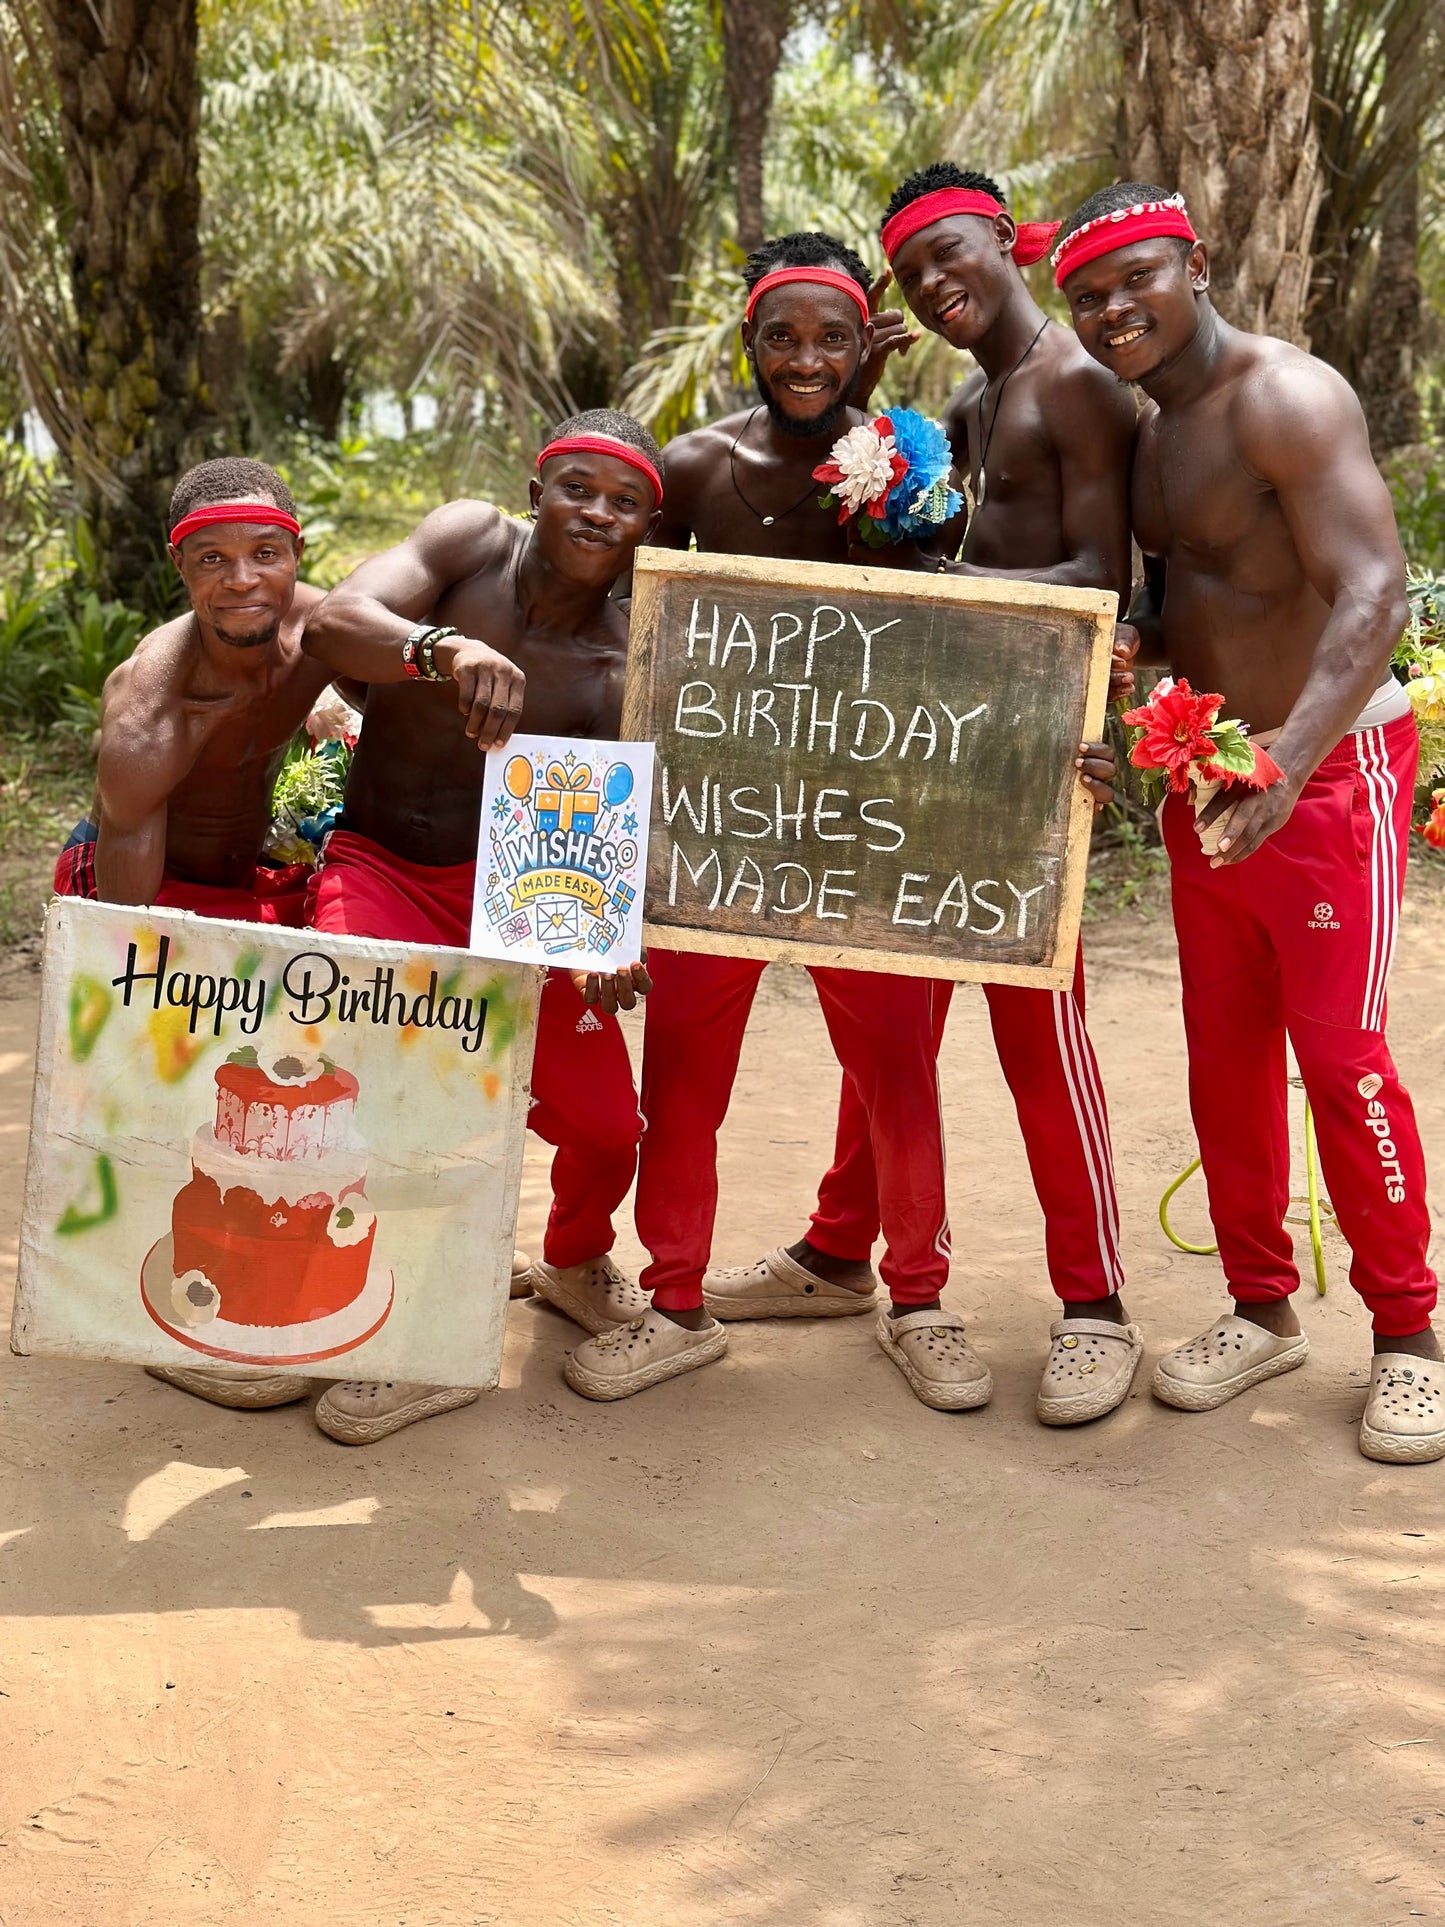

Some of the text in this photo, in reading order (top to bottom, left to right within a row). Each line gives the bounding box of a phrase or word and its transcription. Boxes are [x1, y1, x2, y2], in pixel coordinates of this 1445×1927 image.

[686, 598, 901, 693] HAPPY
[675, 681, 988, 765] BIRTHDAY
[662, 767, 906, 852] WISHES
[523, 875, 599, 898] MADE EASY
[668, 842, 1050, 940] MADE EASY
[1307, 919, 1341, 931] sports
[112, 935, 488, 1052] Happy Birthday
[575, 1022, 604, 1034] sports
[1365, 1100, 1406, 1204] sports
